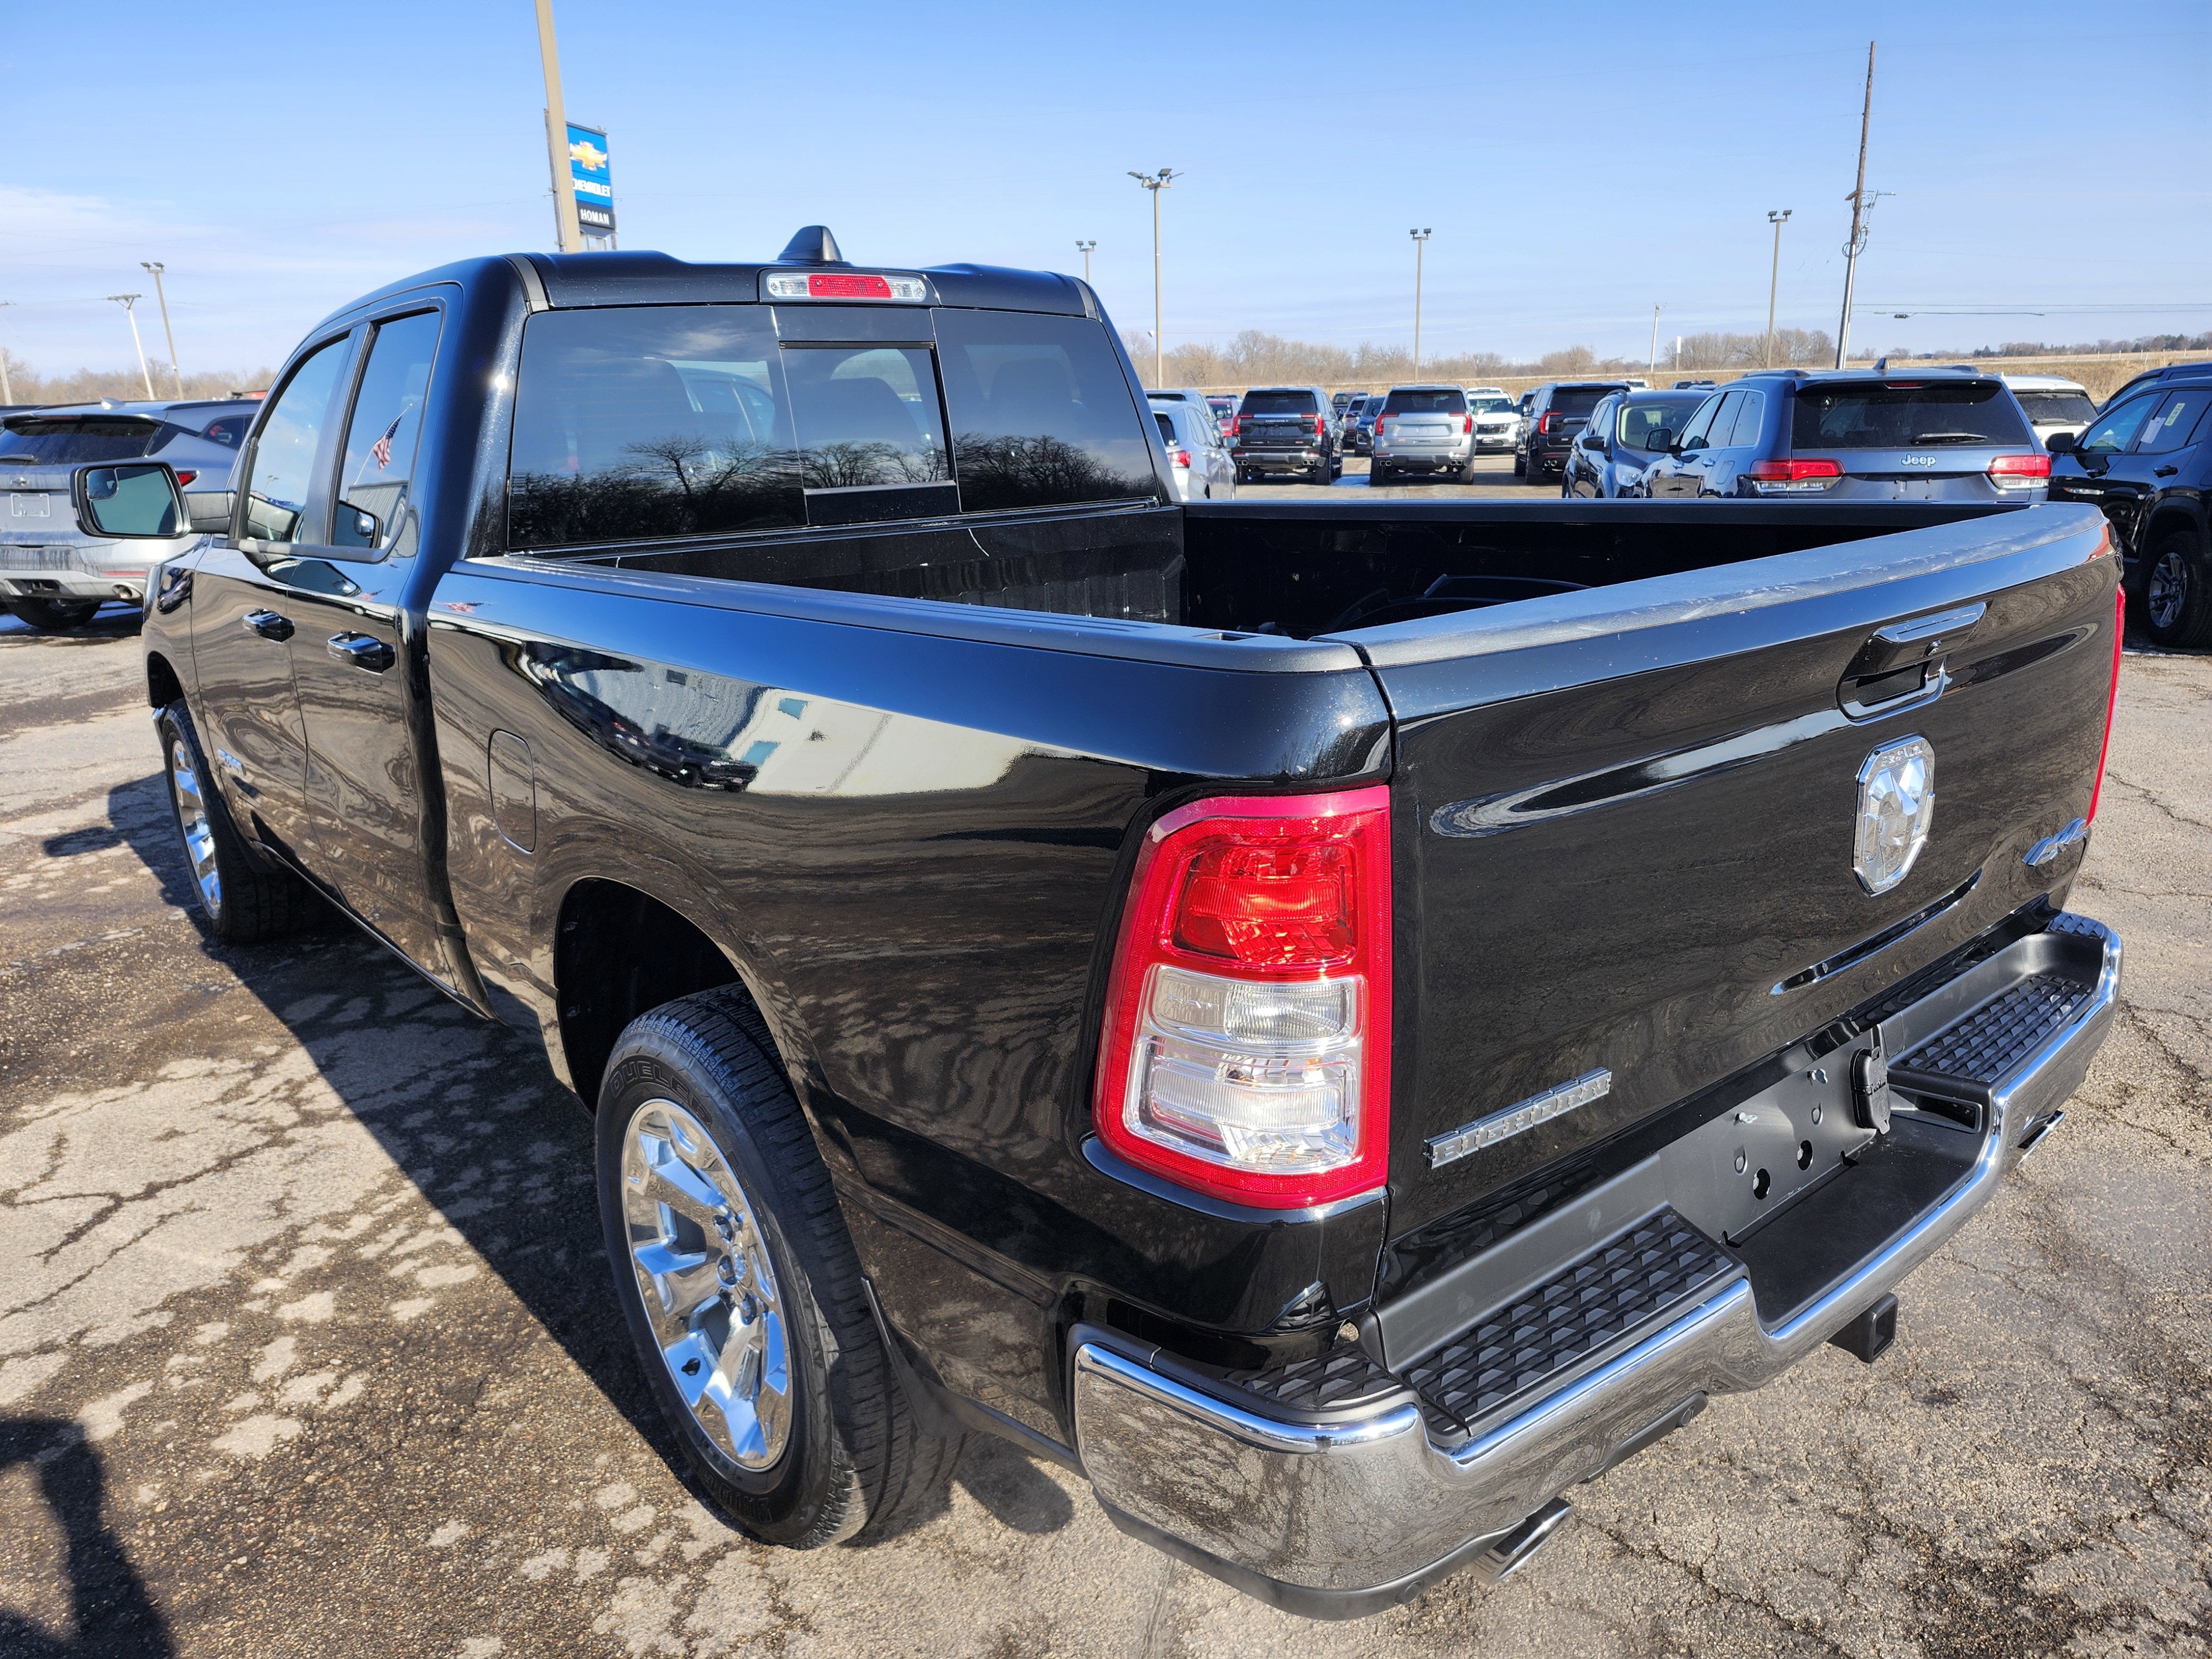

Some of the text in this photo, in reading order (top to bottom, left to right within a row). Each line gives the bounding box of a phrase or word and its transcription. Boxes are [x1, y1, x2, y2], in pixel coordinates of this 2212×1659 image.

[580, 208, 610, 225] HOMAN
[1901, 453, 1937, 467] Jeep
[610, 1060, 712, 1126] DUELER
